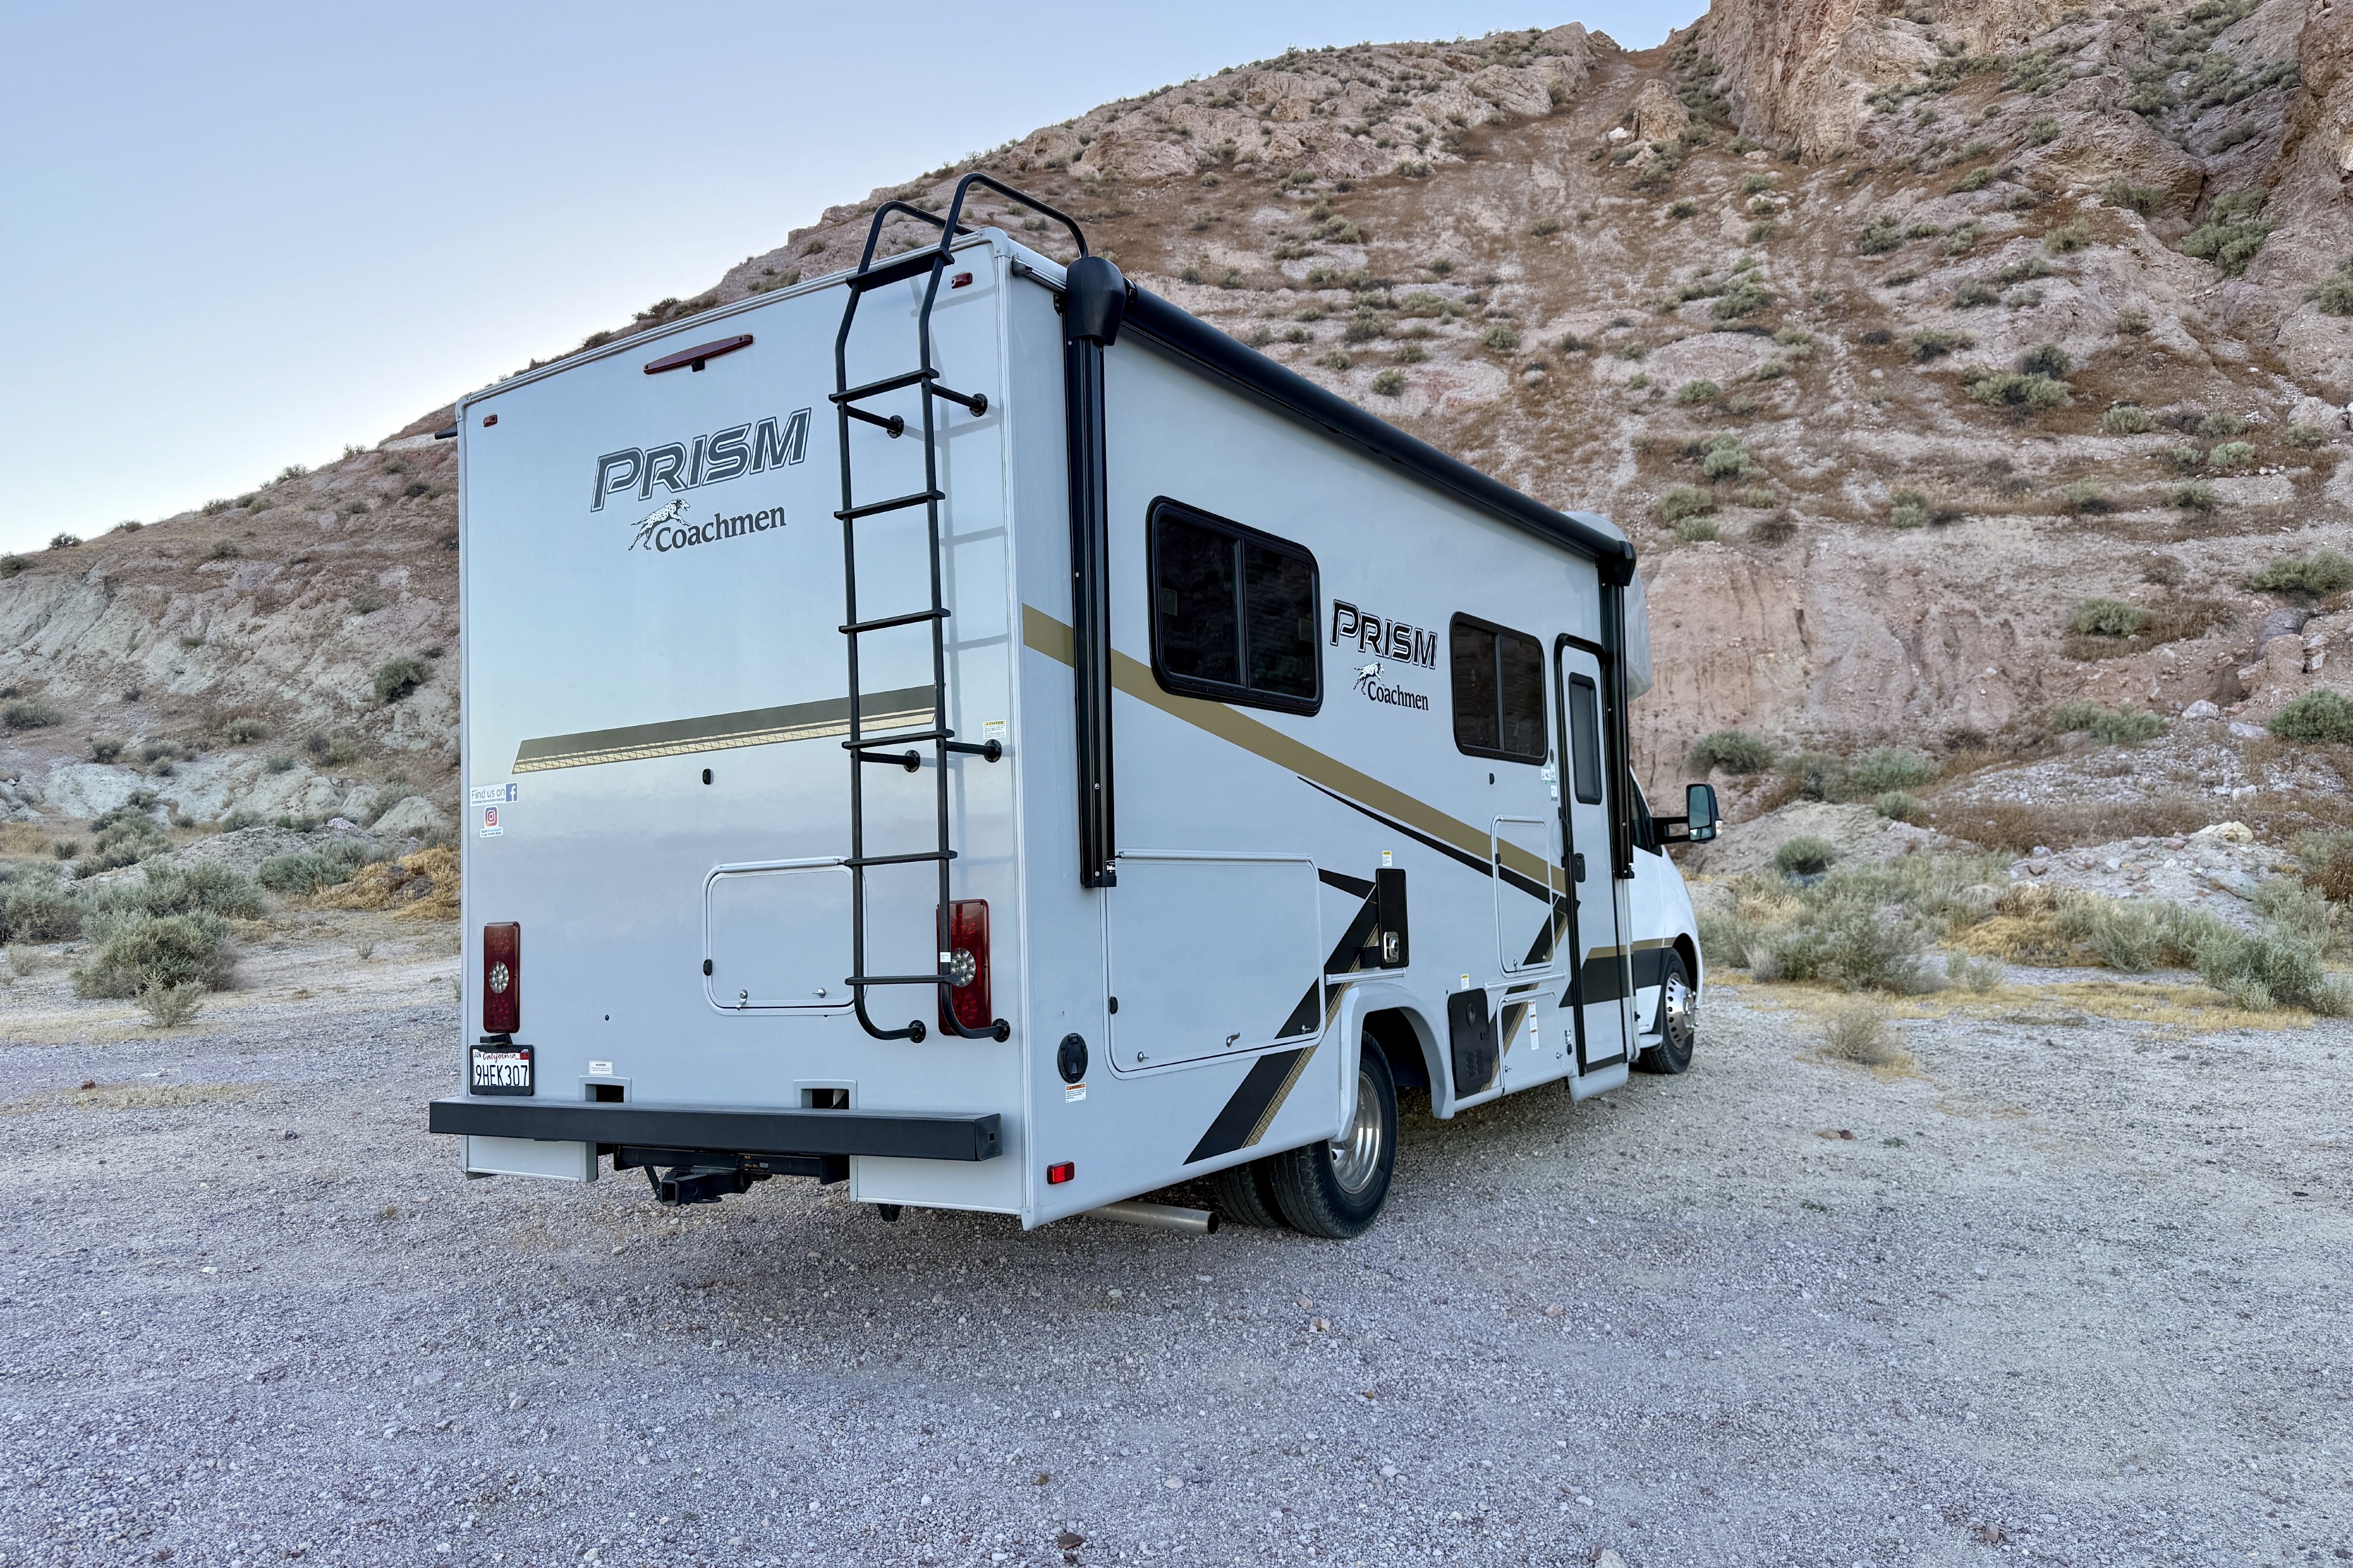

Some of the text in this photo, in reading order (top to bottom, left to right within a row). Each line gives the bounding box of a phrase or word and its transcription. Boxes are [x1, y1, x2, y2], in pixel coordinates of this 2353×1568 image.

[591, 407, 812, 512] PRISM
[655, 506, 787, 553] Coachmen
[1330, 599, 1437, 670] PRISM
[1368, 681, 1429, 711] Coachmen
[472, 788, 485, 799] Find
[487, 789, 495, 798] us
[483, 1052, 520, 1064] California
[476, 1065, 528, 1086] 9HEK307
